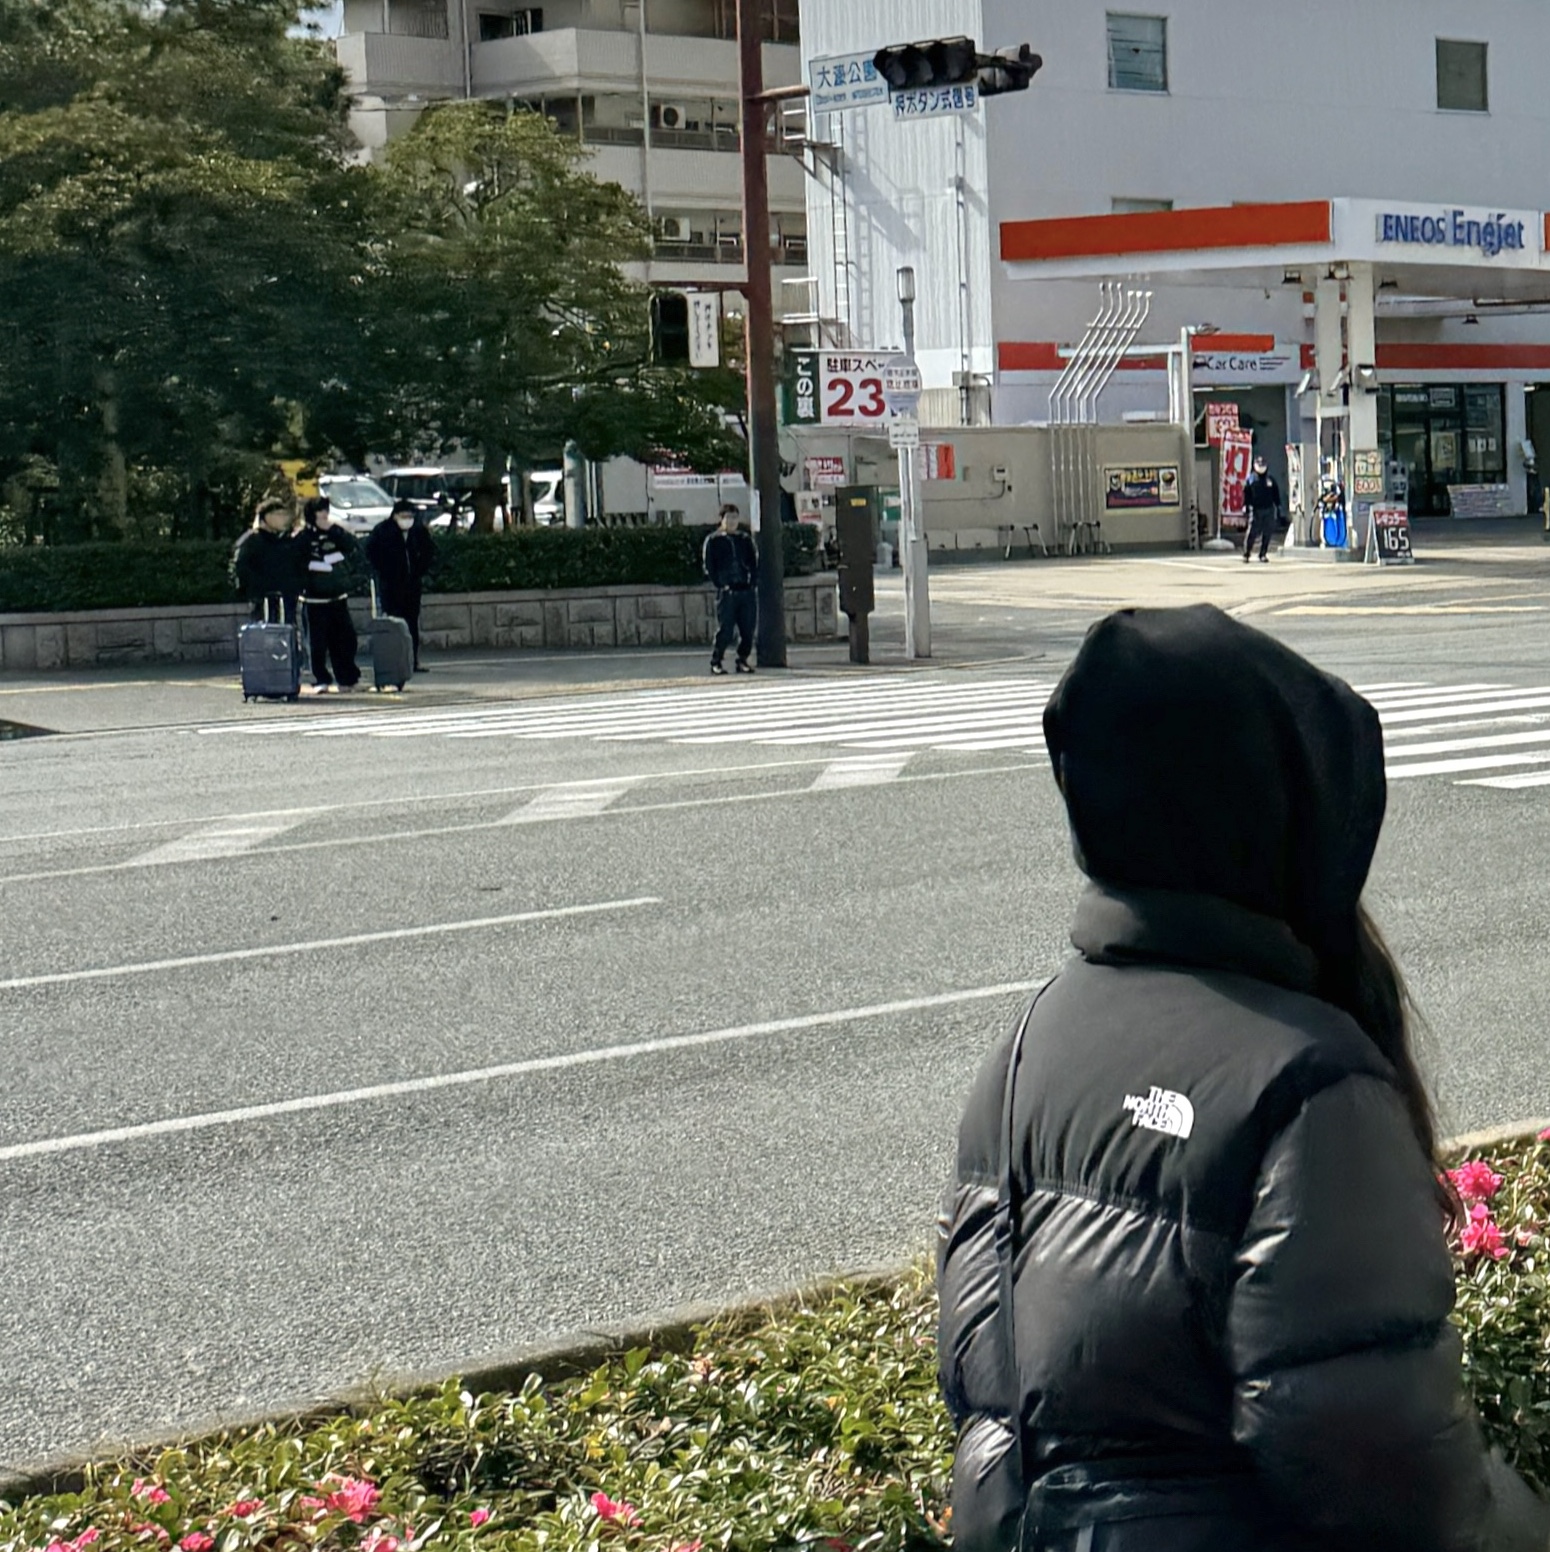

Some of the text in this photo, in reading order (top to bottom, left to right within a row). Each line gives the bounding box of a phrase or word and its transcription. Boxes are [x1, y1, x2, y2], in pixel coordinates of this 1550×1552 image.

[1382, 213, 1446, 243] ENEOS
[1229, 356, 1257, 371] Care
[827, 378, 885, 417] 23
[1384, 527, 1409, 551] 165
